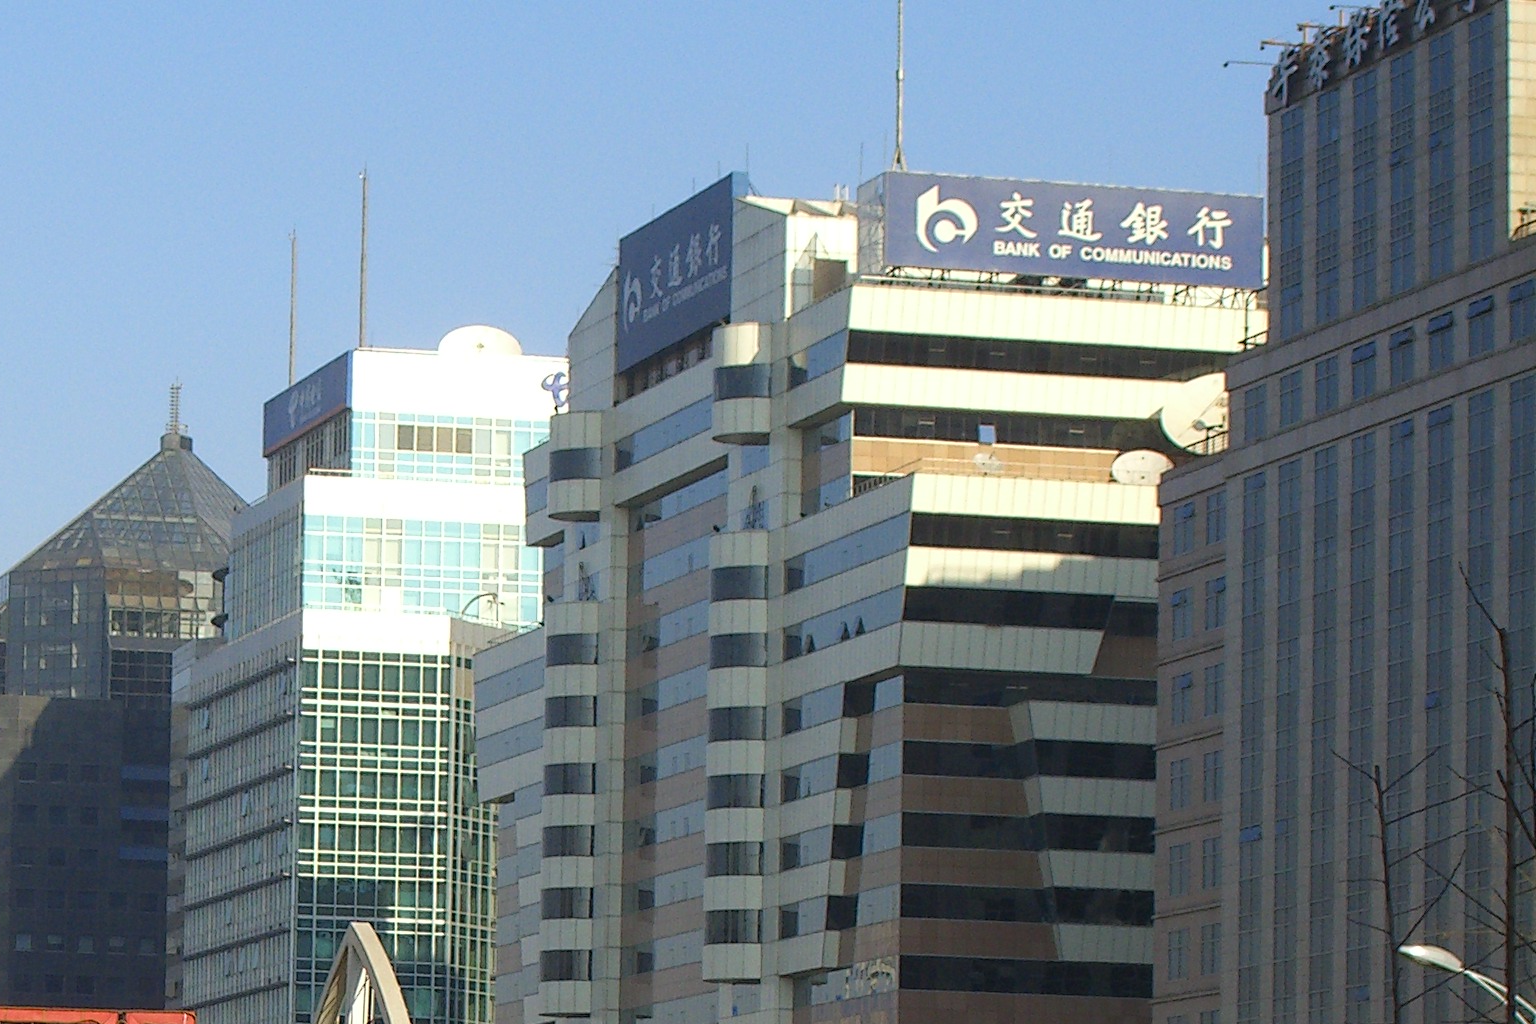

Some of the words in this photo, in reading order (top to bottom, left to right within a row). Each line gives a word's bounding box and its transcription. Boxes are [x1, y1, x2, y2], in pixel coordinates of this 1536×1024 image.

[994, 191, 1234, 250] 交通銀行
[649, 222, 722, 299] 交通銀行
[993, 241, 1041, 258] BANK
[1049, 243, 1073, 260] OF
[1080, 245, 1233, 271] COMMUNICATIONS
